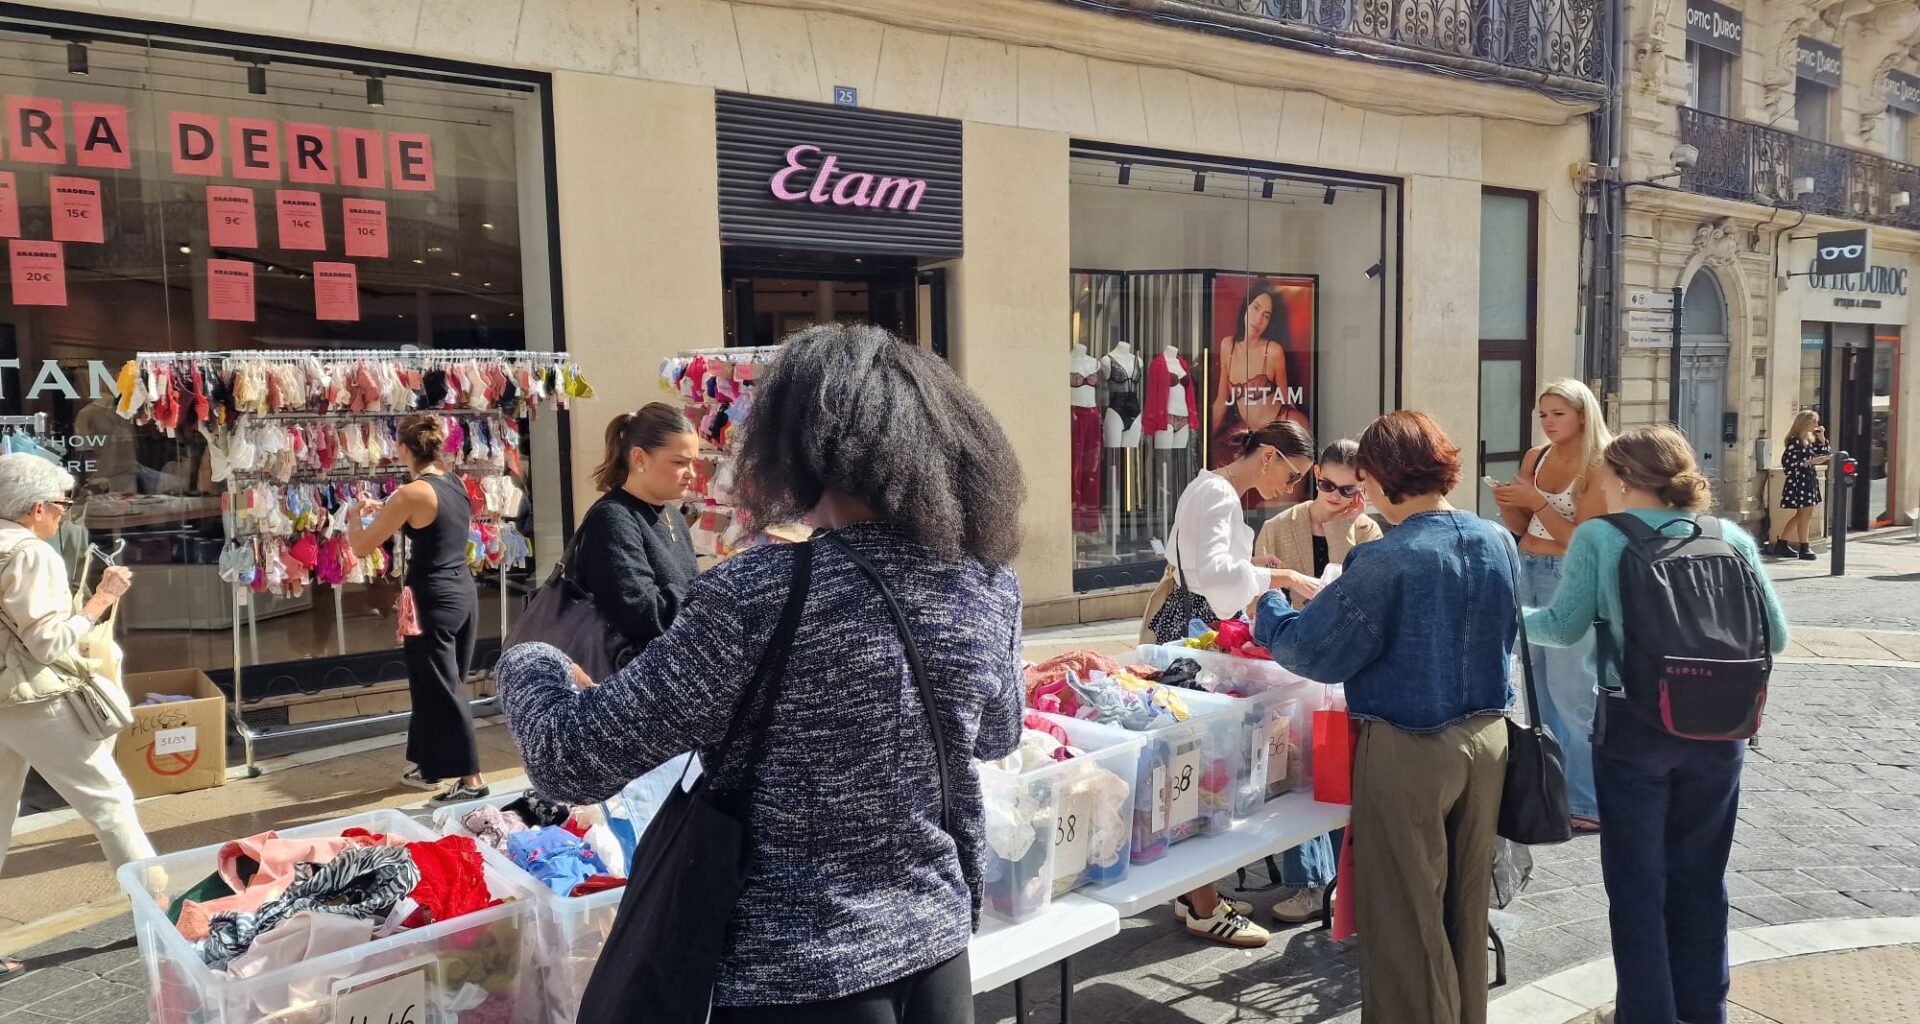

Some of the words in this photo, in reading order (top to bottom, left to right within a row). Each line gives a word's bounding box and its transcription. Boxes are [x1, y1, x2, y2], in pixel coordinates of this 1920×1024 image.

[1687, 8, 1711, 30] OPTIC
[839, 90, 853, 103] 25
[770, 144, 927, 211] Etam
[66, 208, 89, 219] 15€
[225, 216, 241, 226] 9€
[292, 219, 312, 229] 14€
[357, 227, 376, 237] 10€
[26, 272, 52, 282] 20€
[1858, 265, 1908, 295] DUROC
[1224, 386, 1304, 407] J'ETAM
[1665, 666, 1713, 677] KIPSTA
[1269, 736, 1286, 757] 36
[1173, 764, 1194, 801] 38
[1055, 814, 1077, 846] 38
